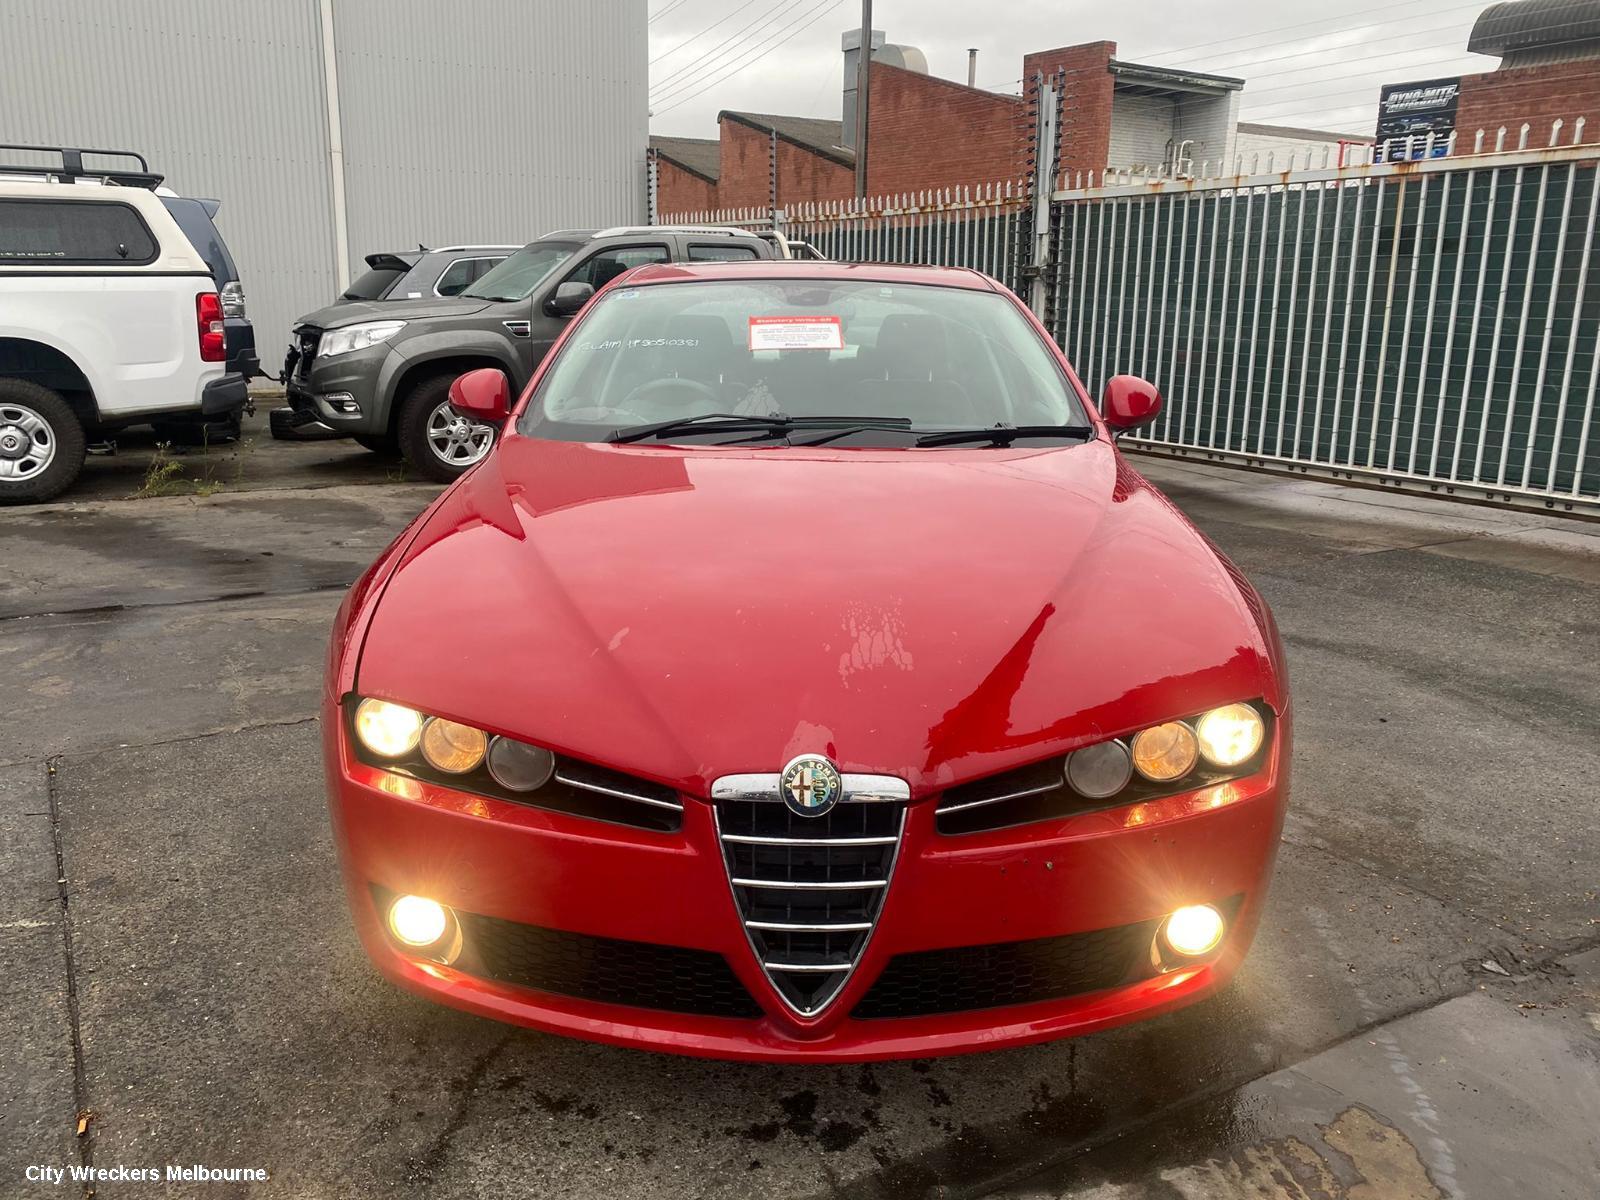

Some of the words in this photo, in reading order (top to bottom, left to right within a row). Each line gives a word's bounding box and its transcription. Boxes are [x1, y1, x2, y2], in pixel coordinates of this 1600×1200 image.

[1388, 86, 1456, 106] DYNO-MITE
[785, 764, 804, 789] ALFA
[808, 761, 837, 789] ROMEO
